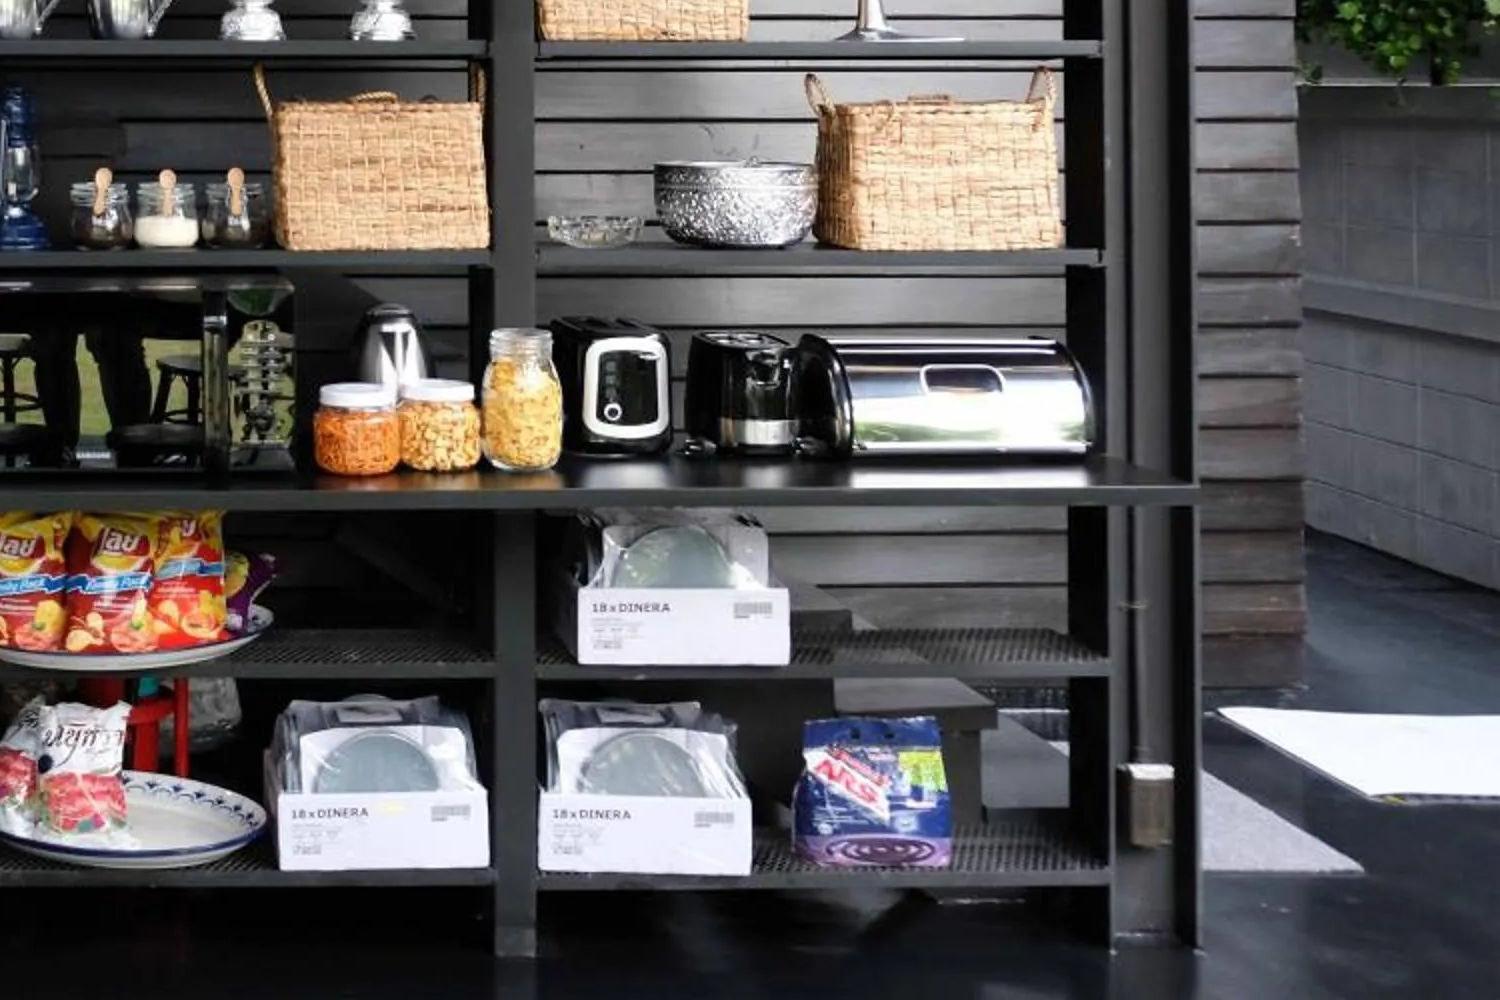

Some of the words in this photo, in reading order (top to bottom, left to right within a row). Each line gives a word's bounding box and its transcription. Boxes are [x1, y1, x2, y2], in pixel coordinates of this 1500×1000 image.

[619, 603, 671, 613] DINERA
[317, 807, 369, 819] DINERA
[579, 809, 631, 820] DINERA
